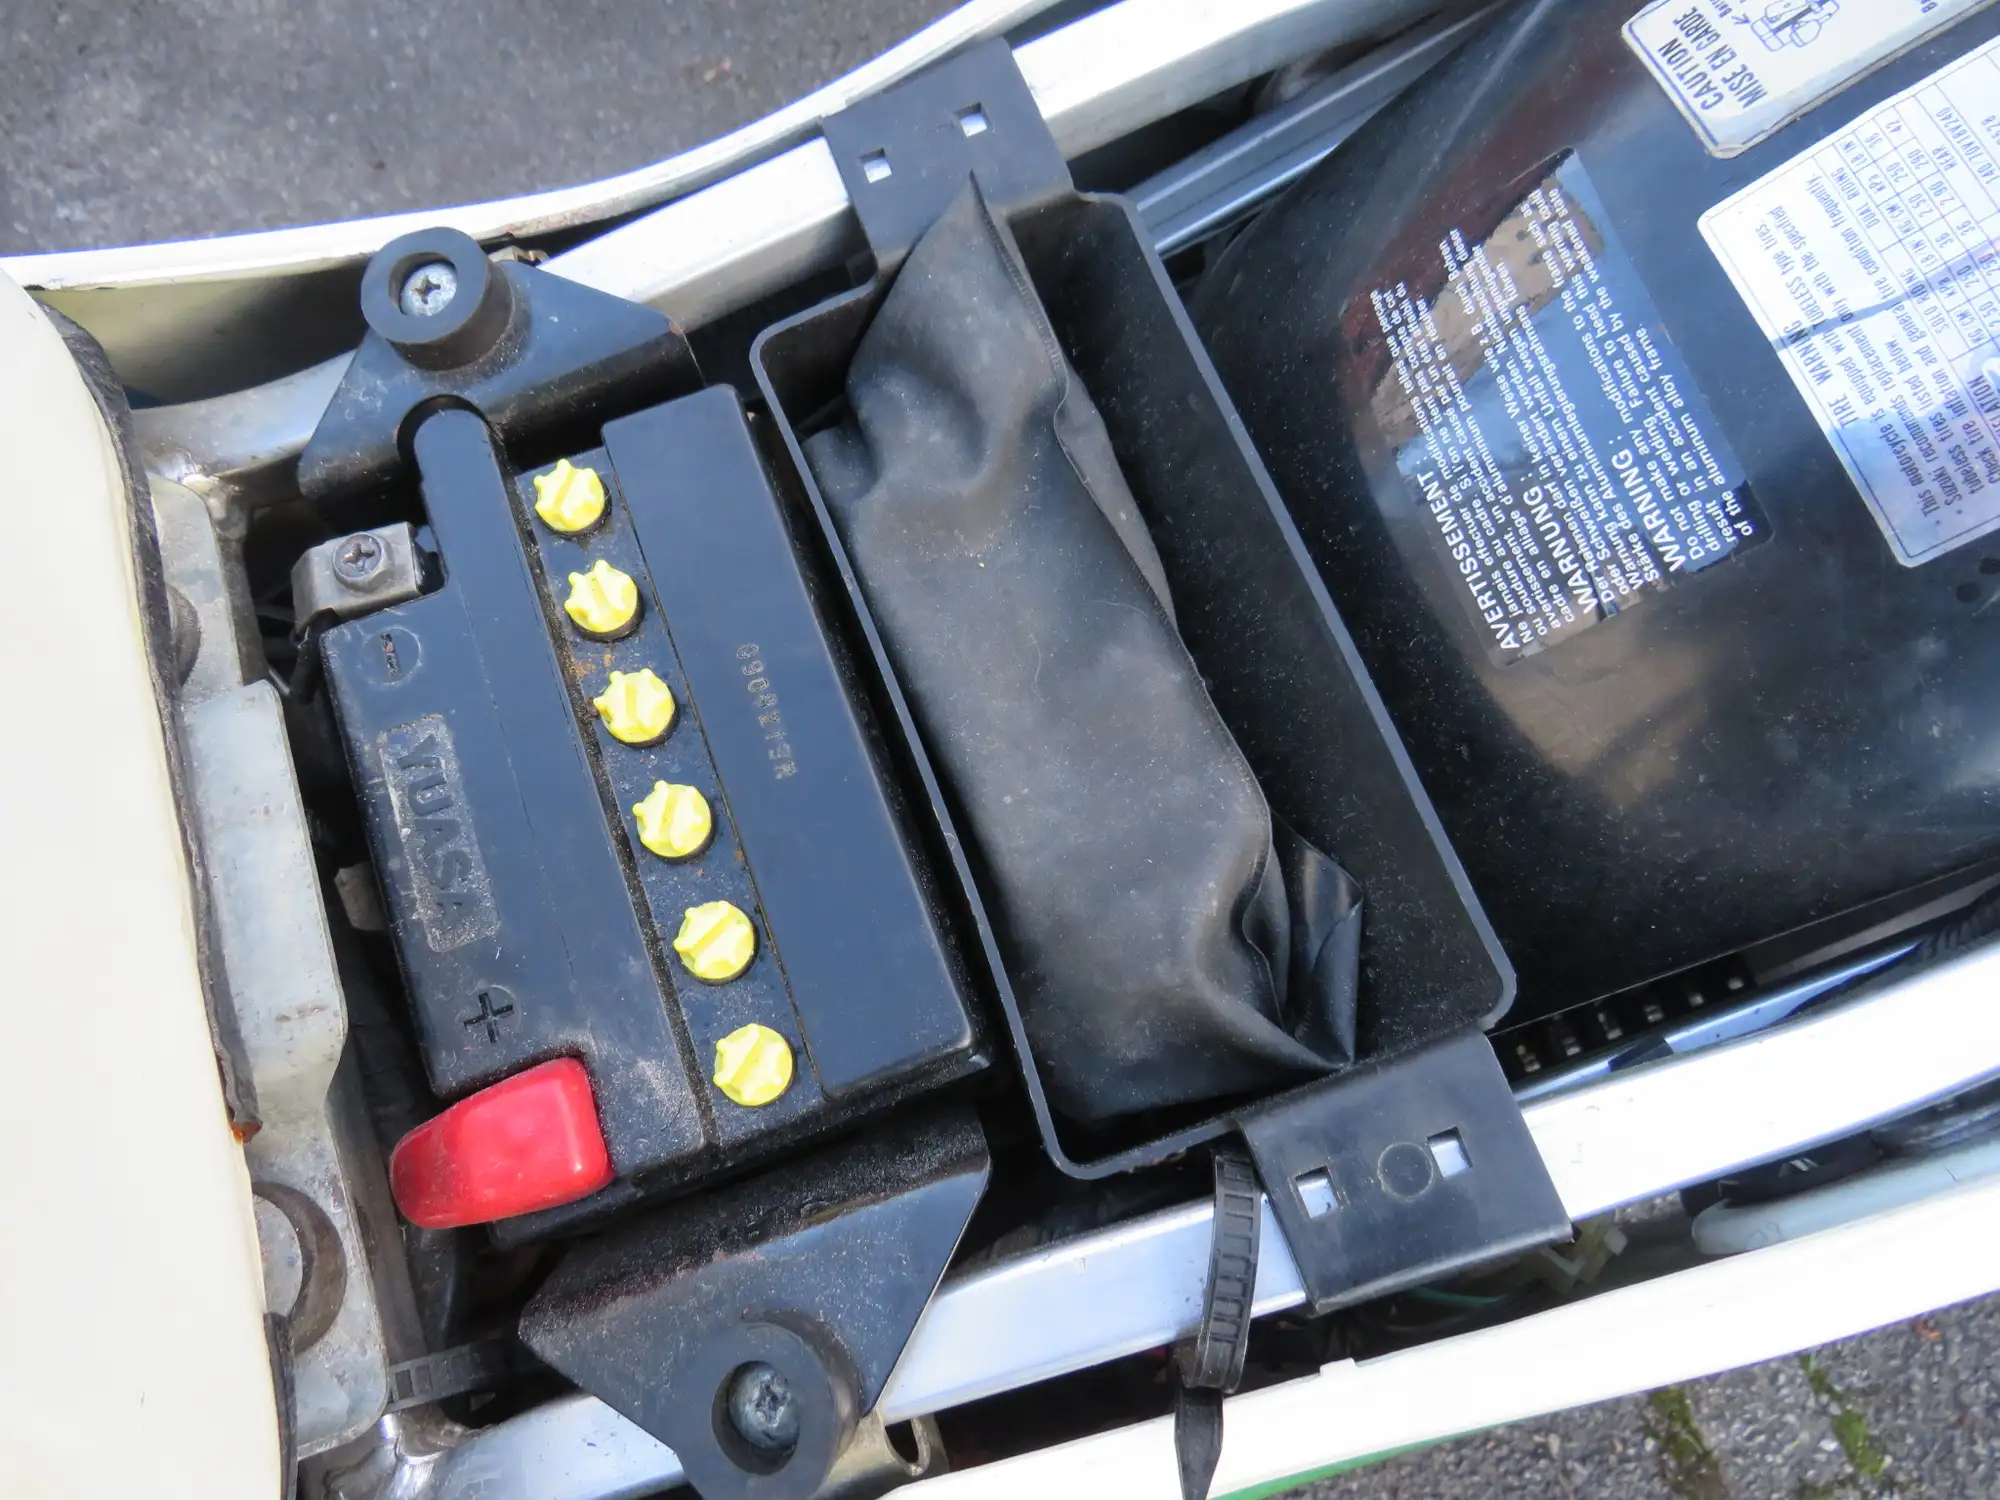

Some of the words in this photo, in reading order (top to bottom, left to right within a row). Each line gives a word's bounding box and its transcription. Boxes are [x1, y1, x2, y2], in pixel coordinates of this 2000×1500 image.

[1672, 5, 1721, 51] GARDE
[1656, 36, 1725, 111] CAUTION
[1703, 43, 1738, 72] EN
[1720, 63, 1768, 109] MISE
[1885, 161, 1909, 184] 250
[1906, 148, 1931, 170] 290
[1931, 145, 1958, 172] REAR
[1830, 166, 1861, 201] RIDING
[1520, 202, 1533, 219] as
[1528, 188, 1552, 221] could
[1548, 187, 1569, 218] state
[1855, 201, 1881, 229] DUAL
[1526, 219, 1547, 248] such
[1765, 204, 1807, 251] specified
[1934, 231, 1954, 249] 36
[1955, 219, 1976, 237] 36
[1438, 239, 1462, 282] Bohren
[1449, 228, 1469, 262] dieser
[1546, 220, 1577, 272] warning
[1560, 218, 1600, 284] weakened
[1800, 251, 1820, 273] the
[1840, 226, 1881, 276] condition
[1542, 249, 1565, 288] frame
[1772, 249, 1795, 276] type
[1953, 263, 1980, 288] 250
[1380, 289, 1396, 309] cet
[1394, 281, 1407, 298] du
[1454, 281, 1475, 315] durch
[1560, 289, 1577, 313] the
[1571, 273, 1589, 300] this
[1595, 286, 1613, 310] the
[1812, 271, 1837, 298] with
[1873, 276, 1896, 301] tire
[1903, 268, 1930, 305] RIDING
[1933, 275, 1957, 298] kPa
[1390, 308, 1402, 328] de
[1462, 258, 1509, 355] Nichtbeachtung
[1785, 275, 1830, 331] TUBELESS
[1833, 299, 1859, 327] only
[1884, 296, 1928, 343] general
[1923, 304, 1950, 334] SOLO
[1572, 314, 1586, 331] to
[1581, 302, 1608, 339] heed
[1607, 312, 1624, 333] by
[1386, 334, 1401, 358] que
[1396, 325, 1423, 370] compte
[1415, 337, 1433, 364] état
[1434, 343, 1447, 361] en
[1508, 327, 1535, 373] wegen
[1603, 339, 1617, 356] to
[1615, 333, 1651, 383] caused
[1635, 323, 1663, 371] frame.
[1784, 320, 1832, 385] WARNING
[1820, 326, 1846, 356] with
[1844, 323, 1897, 392] replacement
[1912, 344, 1938, 368] and
[1395, 359, 1414, 395] telles
[1427, 364, 1440, 383] un
[1483, 347, 1501, 374] wie
[1414, 369, 1433, 394] pas
[1434, 383, 1453, 405] par
[1441, 362, 1473, 413] pourrait
[1505, 355, 1535, 410] werden.
[1581, 332, 1634, 424] modifications
[1612, 358, 1644, 409] Failure
[1658, 374, 1684, 409] alloy
[1835, 355, 1877, 406] equipped
[1903, 373, 1935, 412] listed
[1931, 369, 1970, 421] inflation
[1423, 394, 1443, 426] tient
[1495, 374, 1521, 419] Weise
[1515, 304, 1617, 500] Aluminiumlegierungsrahmens
[1526, 374, 1555, 417] Unfall
[1827, 393, 1861, 430] TIRE
[1442, 406, 1468, 445] causé
[1644, 385, 1685, 447] accident
[1868, 407, 1887, 425] is
[1892, 398, 1940, 467] recommends
[1928, 411, 1955, 443] tires
[1409, 395, 1453, 481] modifications
[1438, 426, 1452, 444] ne
[1516, 419, 1543, 464] keiner
[1528, 410, 1568, 477] verändert
[1551, 417, 1578, 461] einem
[1628, 428, 1651, 456] any
[1642, 412, 1680, 477] welding.
[1680, 412, 1726, 486] aluminum
[1961, 420, 1985, 447] tire
[1447, 445, 1465, 473] l'on
[1538, 463, 1552, 480] in
[1573, 463, 1589, 482] zu
[1680, 451, 1698, 471] an
[1878, 423, 1925, 488] motorcycle
[1947, 443, 1985, 495] tubeless
[1456, 472, 1473, 490] Si
[1461, 445, 1496, 503] accident
[1646, 460, 1675, 502] make
[1675, 481, 1691, 496] or
[1693, 475, 1708, 493] in
[1927, 465, 1963, 506] Suzuki
[1448, 484, 1463, 502] de
[1543, 481, 1568, 510] darf
[1583, 483, 1609, 522] kann
[1611, 448, 1687, 572] WARNING
[1721, 489, 1742, 516] the
[1916, 488, 1941, 518] This
[1471, 493, 1496, 537] cadre.
[1491, 504, 1506, 524] un
[1563, 478, 1611, 561] Schweißen
[1611, 502, 1633, 530] des
[1668, 505, 1691, 532] not
[1686, 499, 1721, 551] drilling
[1704, 499, 1737, 543] result
[1733, 520, 1753, 536] of
[1458, 506, 1494, 566] effectuer
[1491, 538, 1506, 557] au
[1509, 509, 1540, 556] alliage
[1562, 511, 1600, 573] Rahmen
[1686, 535, 1705, 561] Do
[1416, 470, 1521, 649] AVERTISSEMENT
[1522, 485, 1598, 615] WARNUNG
[1603, 520, 1647, 590] Warnung
[1627, 532, 1660, 582] Stärke
[1502, 527, 1563, 630] avertissement,
[1535, 559, 1552, 579] en
[1606, 563, 1630, 595] oder
[1490, 569, 1524, 618] jamais
[1502, 559, 1537, 615] soudure
[1548, 583, 1576, 624] cadre
[1594, 575, 1616, 604] Der
[1517, 620, 1535, 644] Ne
[1532, 617, 1548, 636] ou
[396, 733, 484, 923] YUASA
